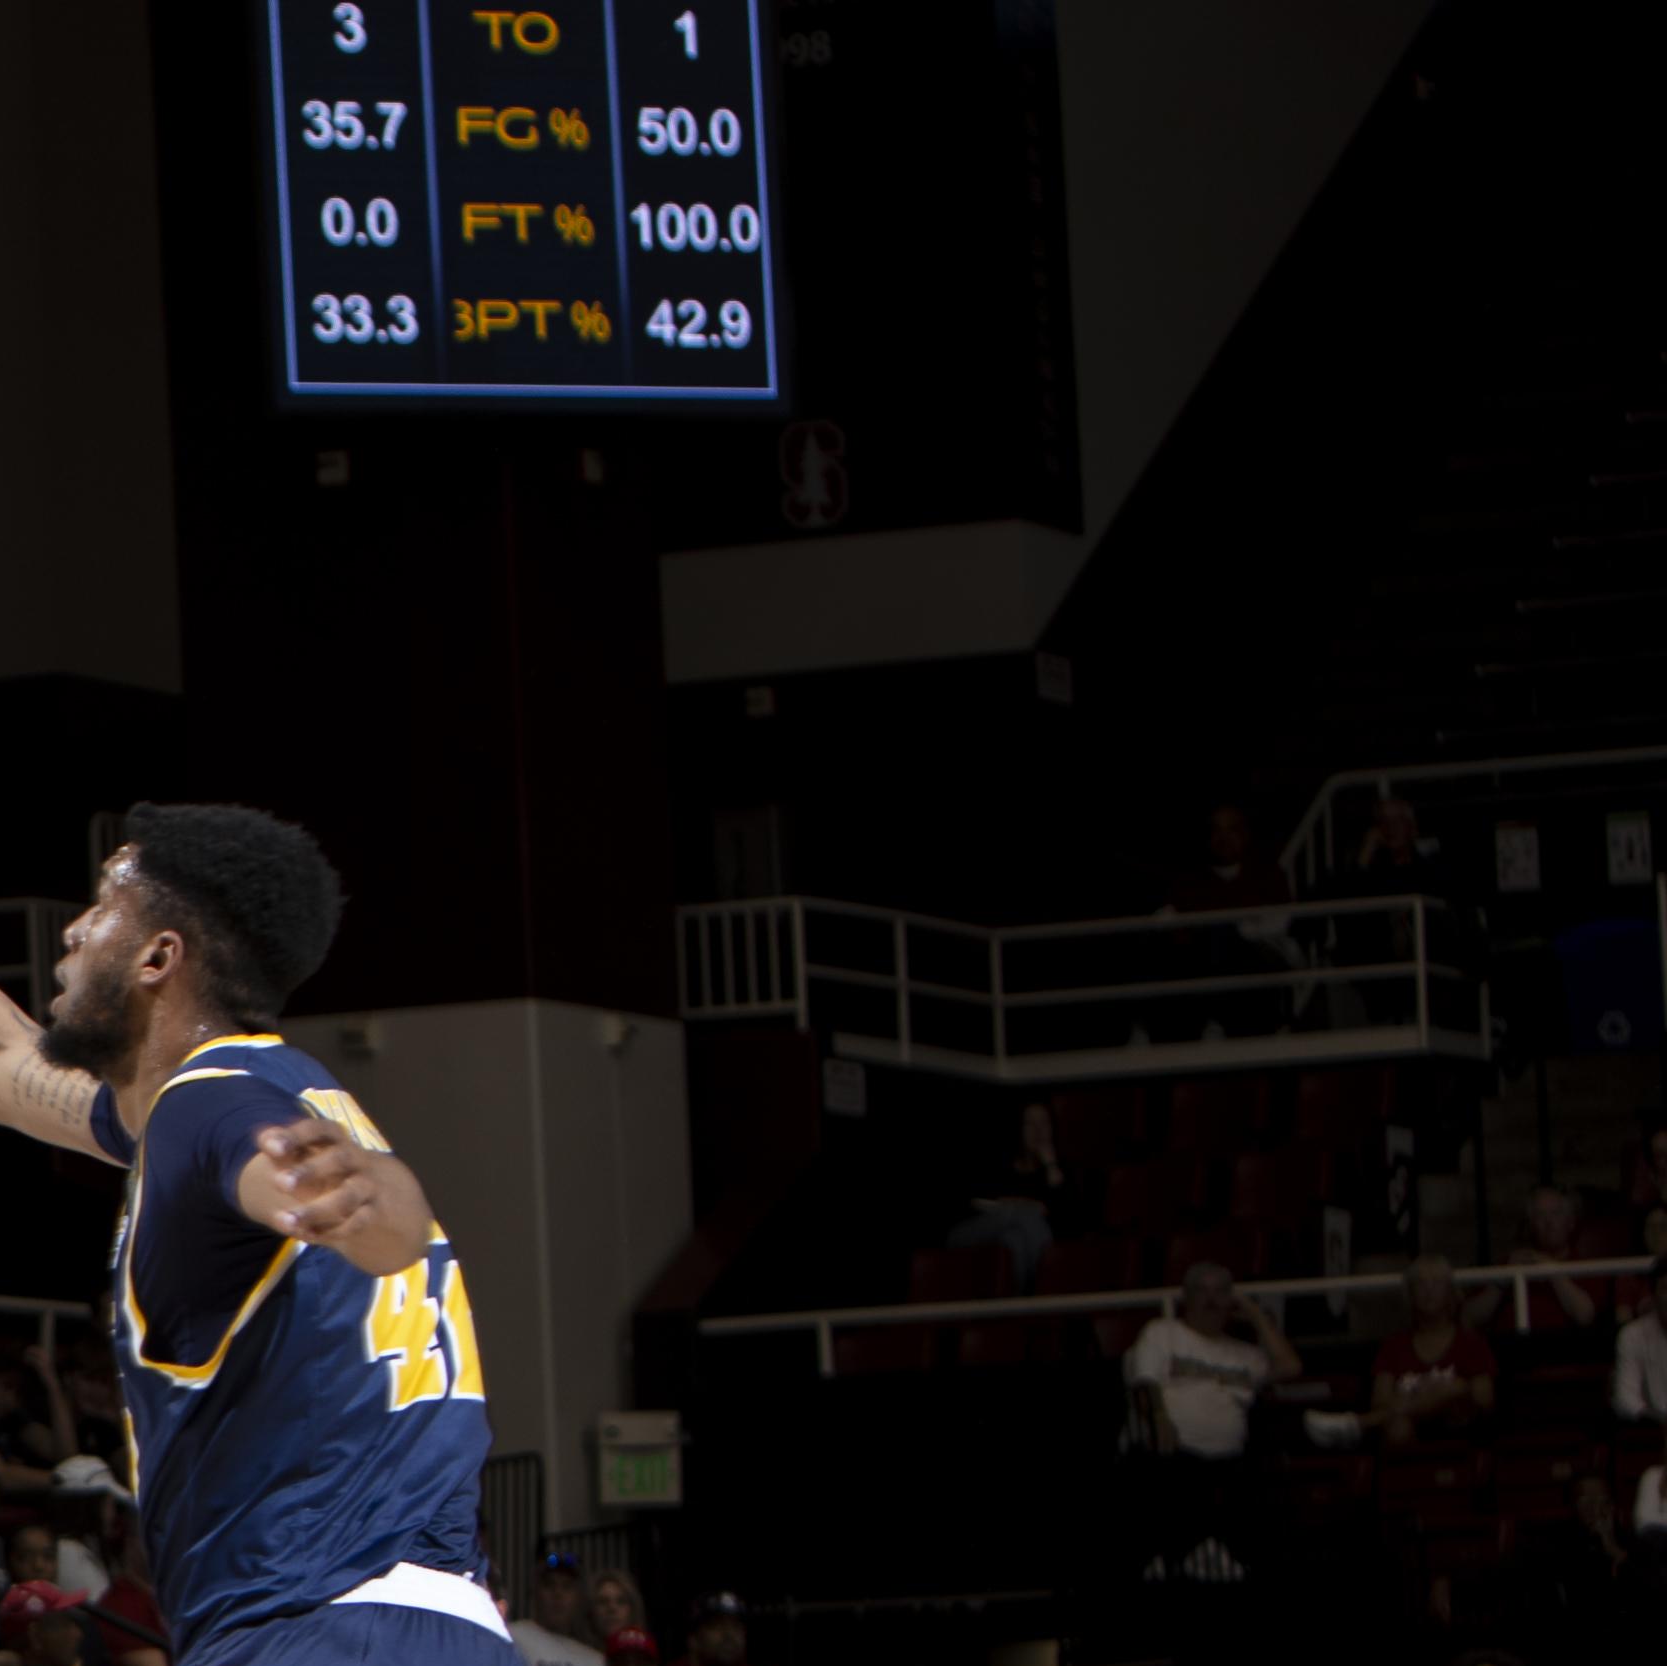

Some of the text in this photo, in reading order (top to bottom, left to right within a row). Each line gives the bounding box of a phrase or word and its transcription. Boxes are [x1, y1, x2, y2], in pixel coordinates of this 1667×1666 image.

[333, 2, 369, 54] 3
[472, 10, 560, 54] TO
[673, 10, 699, 60] 1
[301, 99, 408, 151] 35.7
[456, 106, 591, 150] FG %
[637, 106, 742, 157] 50.0
[320, 197, 400, 248] 0.0
[462, 202, 596, 246] FT %
[630, 203, 762, 253] 100.0
[311, 293, 420, 345] 33.3
[570, 300, 612, 343] %
[645, 299, 753, 349] 42.9
